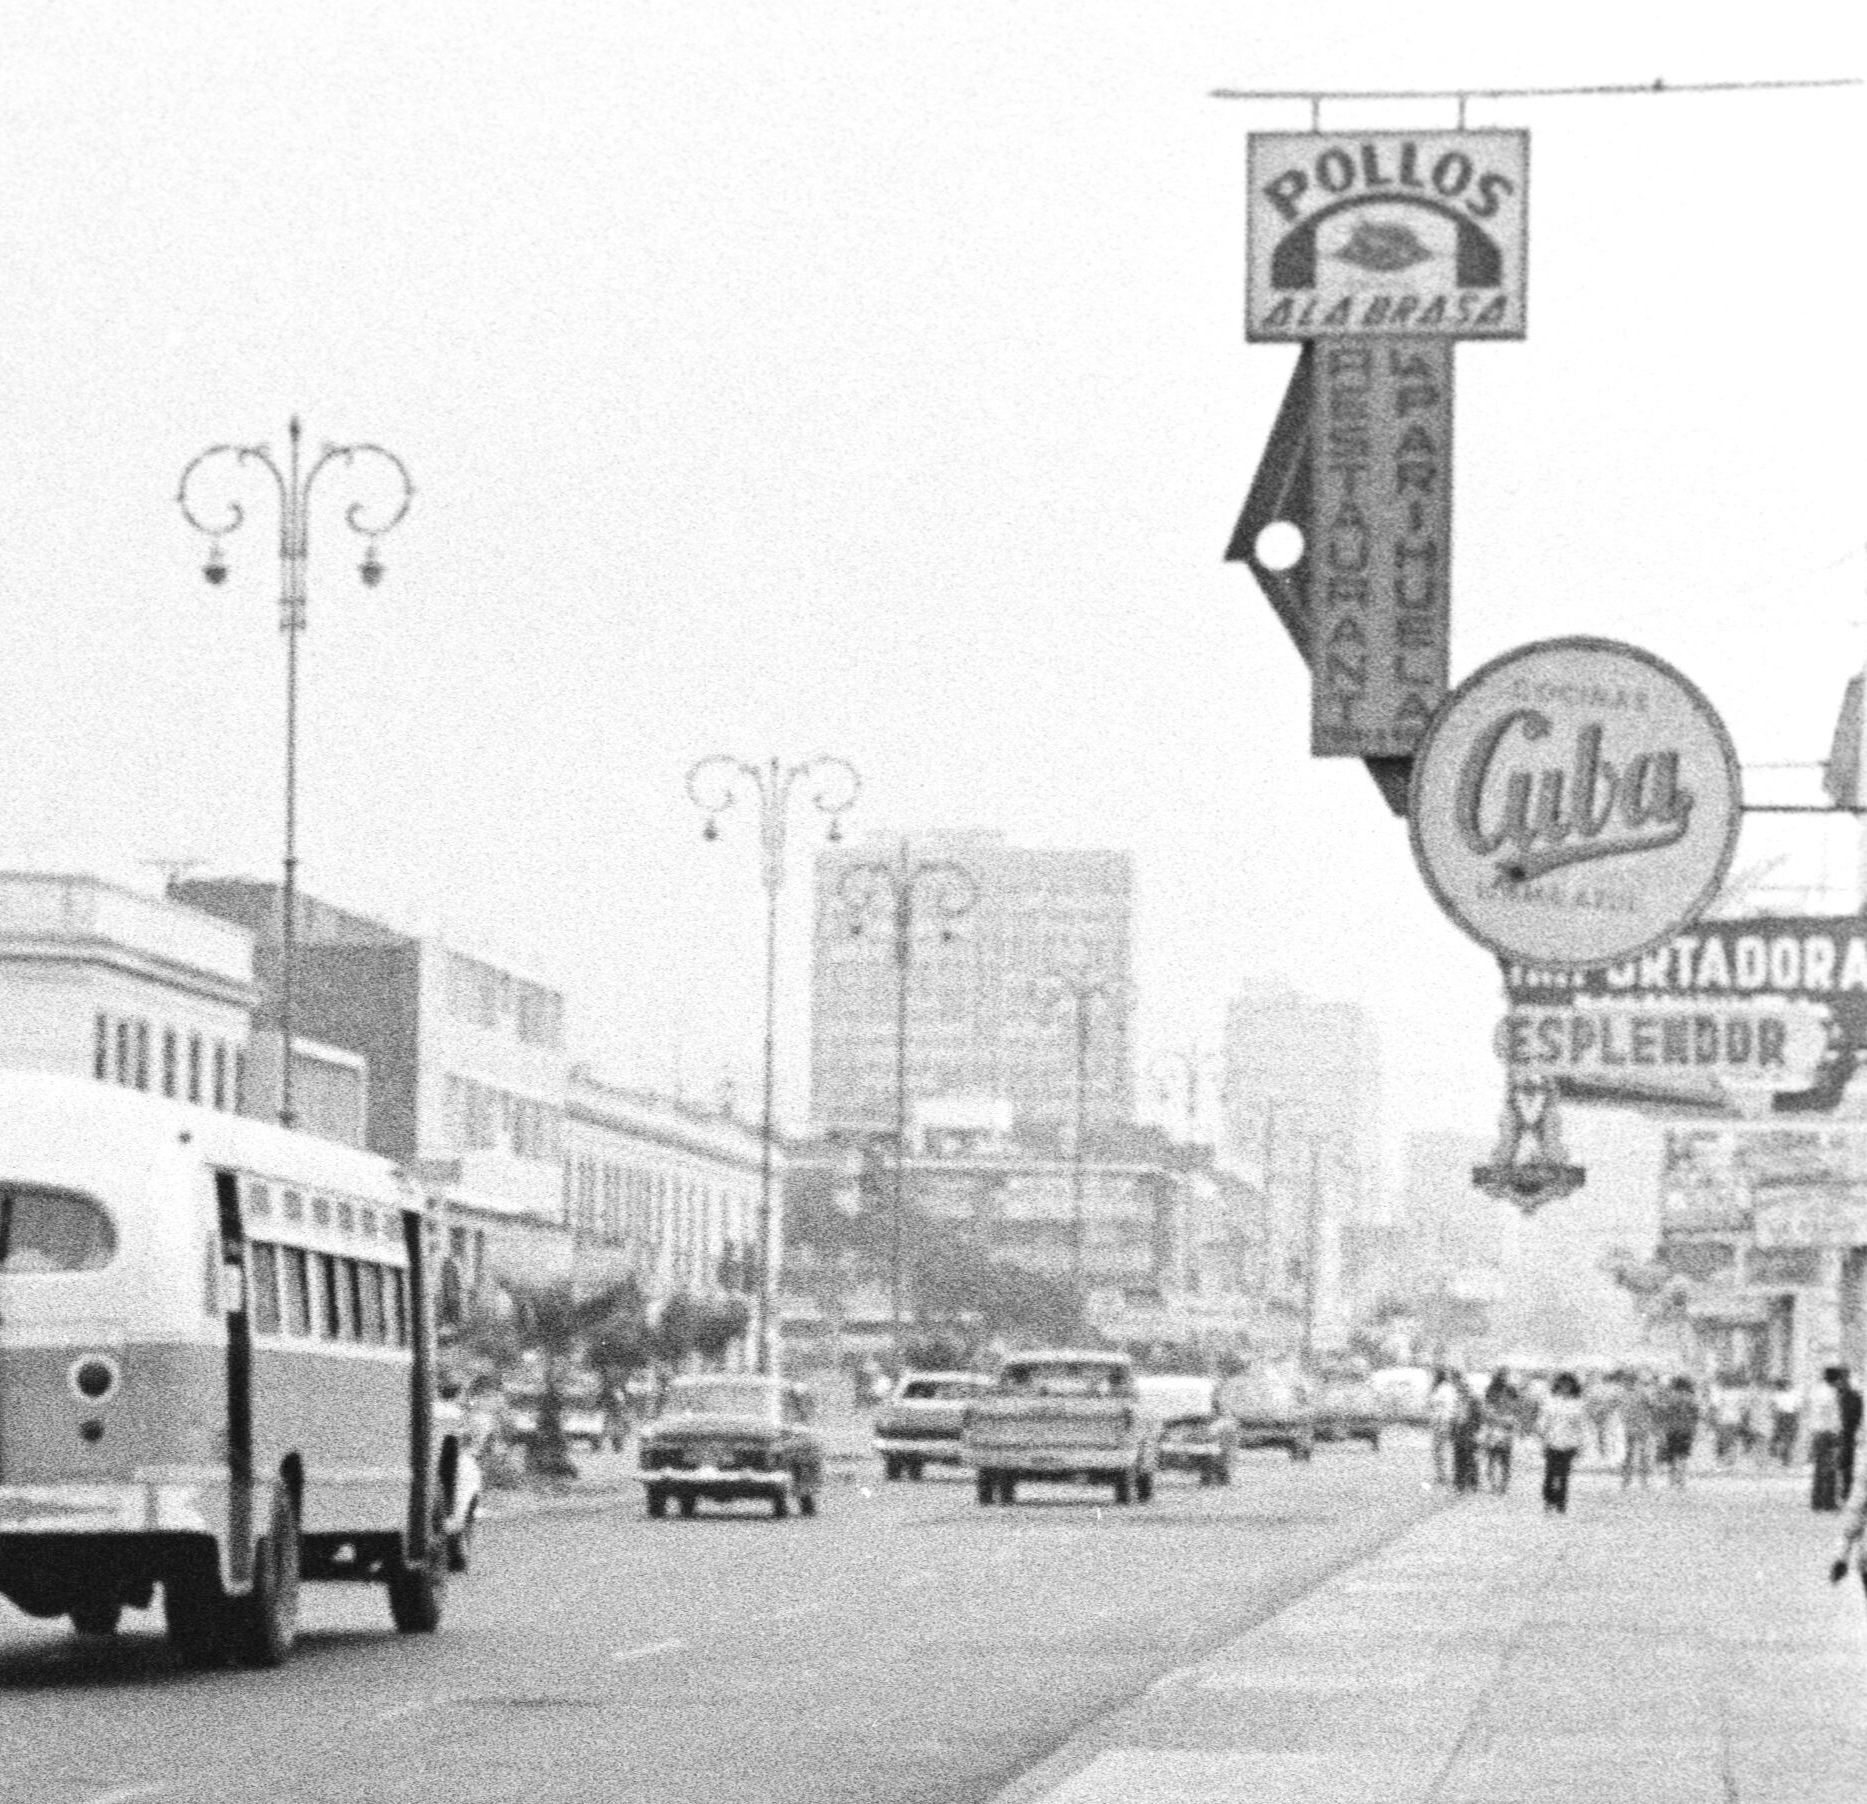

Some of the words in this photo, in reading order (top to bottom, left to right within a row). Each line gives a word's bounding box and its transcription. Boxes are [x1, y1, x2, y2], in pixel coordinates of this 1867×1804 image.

[1262, 140, 1515, 222] POLLOS
[1261, 294, 1295, 328] A
[1297, 294, 1353, 328] LA
[1363, 294, 1508, 328] BRASA
[1327, 347, 1372, 725] RESTAURANT
[1455, 707, 1695, 858] Cuba
[1511, 1015, 1788, 1068] ESPLENDOR
